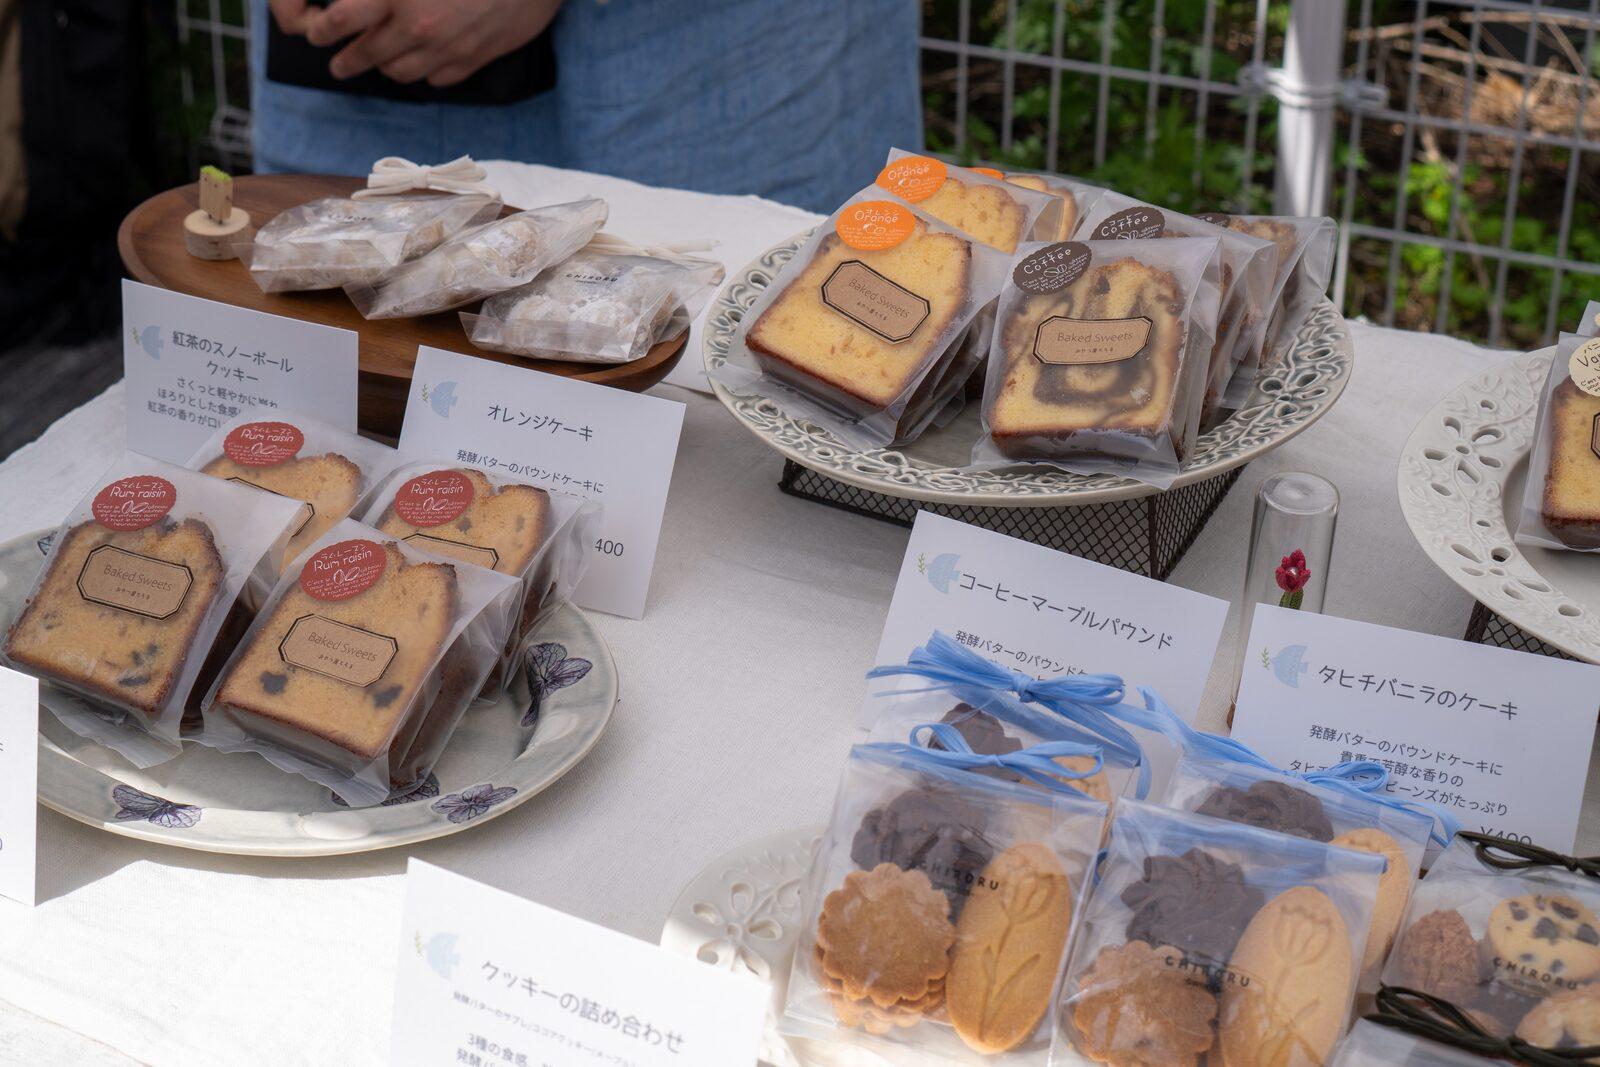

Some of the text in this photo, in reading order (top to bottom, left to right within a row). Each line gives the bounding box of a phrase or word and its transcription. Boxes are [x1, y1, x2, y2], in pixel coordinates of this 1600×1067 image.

[854, 210, 898, 224] Orange
[1101, 215, 1149, 237] Coffee
[1023, 248, 1072, 275] Coffee
[848, 279, 910, 319] Baked Sweets
[1057, 331, 1134, 343] Baked Sweets
[206, 360, 259, 383] クッキー
[147, 400, 222, 429] 紅茶の香りが口
[157, 387, 243, 419] ほろりとした食感
[240, 428, 295, 443] Rum raisin
[487, 404, 594, 442] オレンジケーキ
[456, 449, 605, 494] 発酵バターのパウンドケーキに
[109, 485, 167, 499] Rum raisin
[410, 483, 464, 495] Rum raisin
[314, 549, 372, 572] Rum raisin
[103, 564, 173, 592] Baked Sweets
[307, 631, 377, 662] Baked Sweets
[1318, 664, 1519, 720] タヒチバニラのケーキ
[1309, 724, 1504, 776] 発酵バターのパウンドケーキに
[481, 960, 685, 1055] クッキーの詰め合わせ
